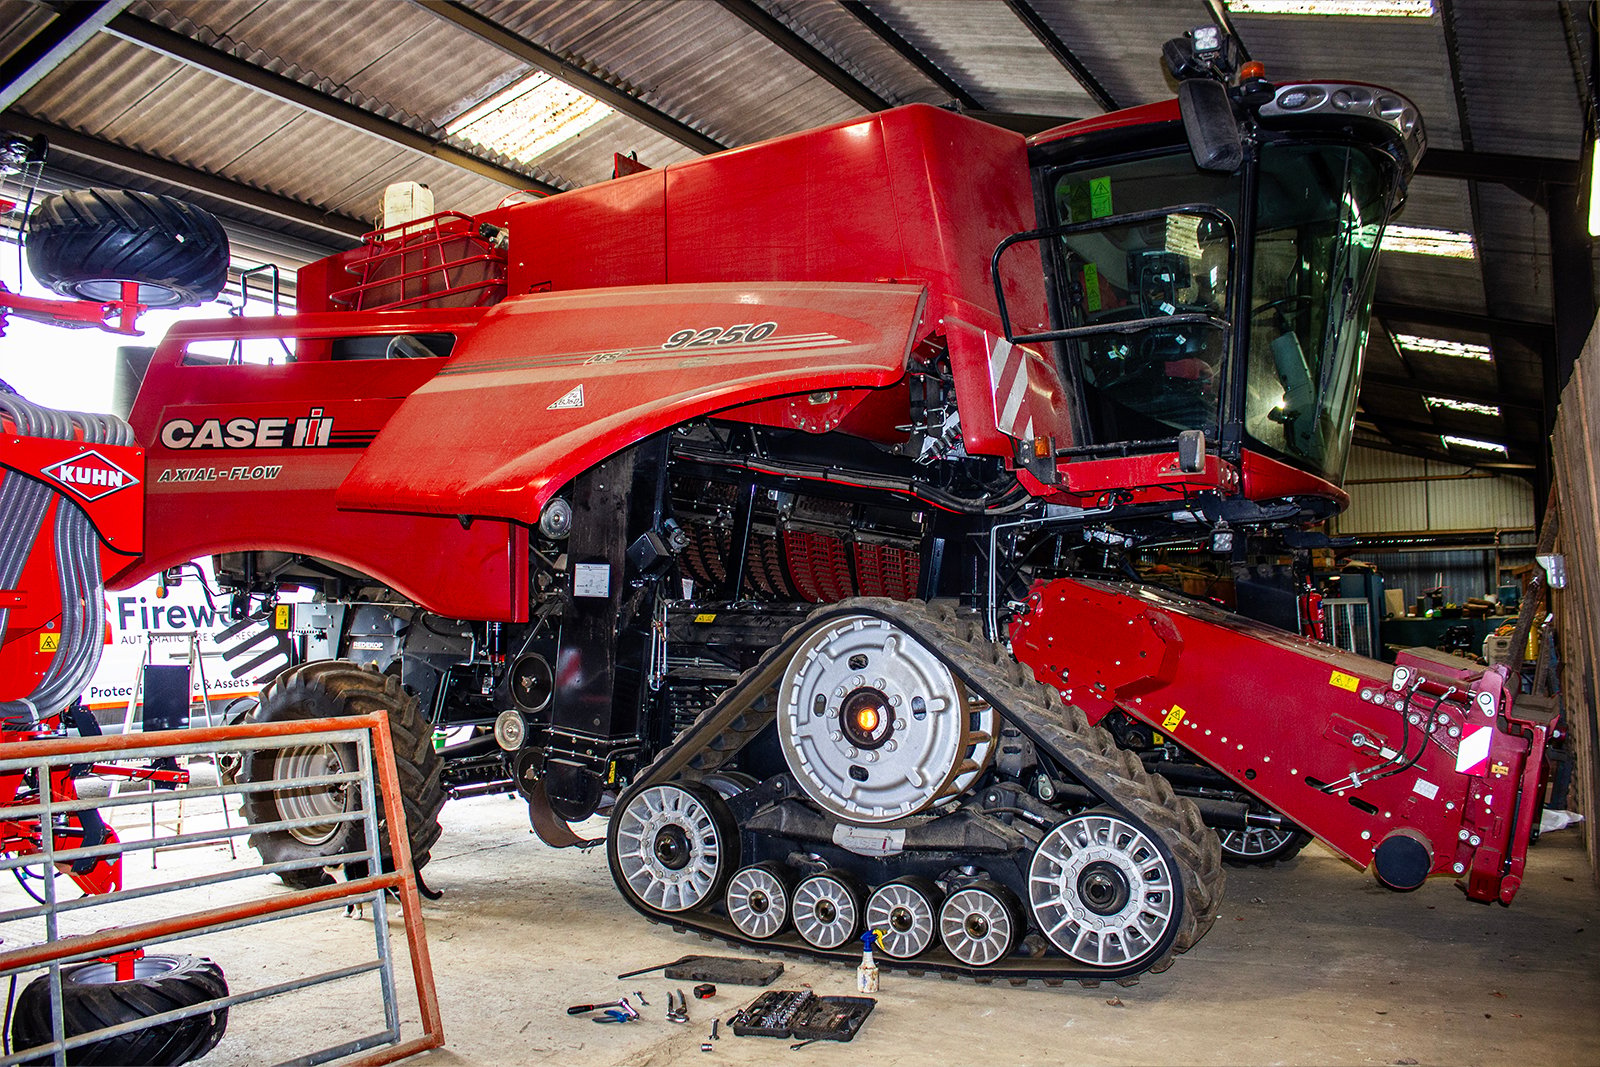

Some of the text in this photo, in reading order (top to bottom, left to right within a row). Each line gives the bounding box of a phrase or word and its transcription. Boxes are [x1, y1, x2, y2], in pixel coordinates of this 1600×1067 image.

[662, 322, 777, 349] 9250
[161, 418, 287, 448] CASE
[59, 465, 124, 488] KUHN
[158, 465, 283, 483] AXIAL-FLOW
[117, 594, 270, 630] Firew
[121, 634, 184, 644] AUTMATIC
[214, 678, 250, 690] Assets
